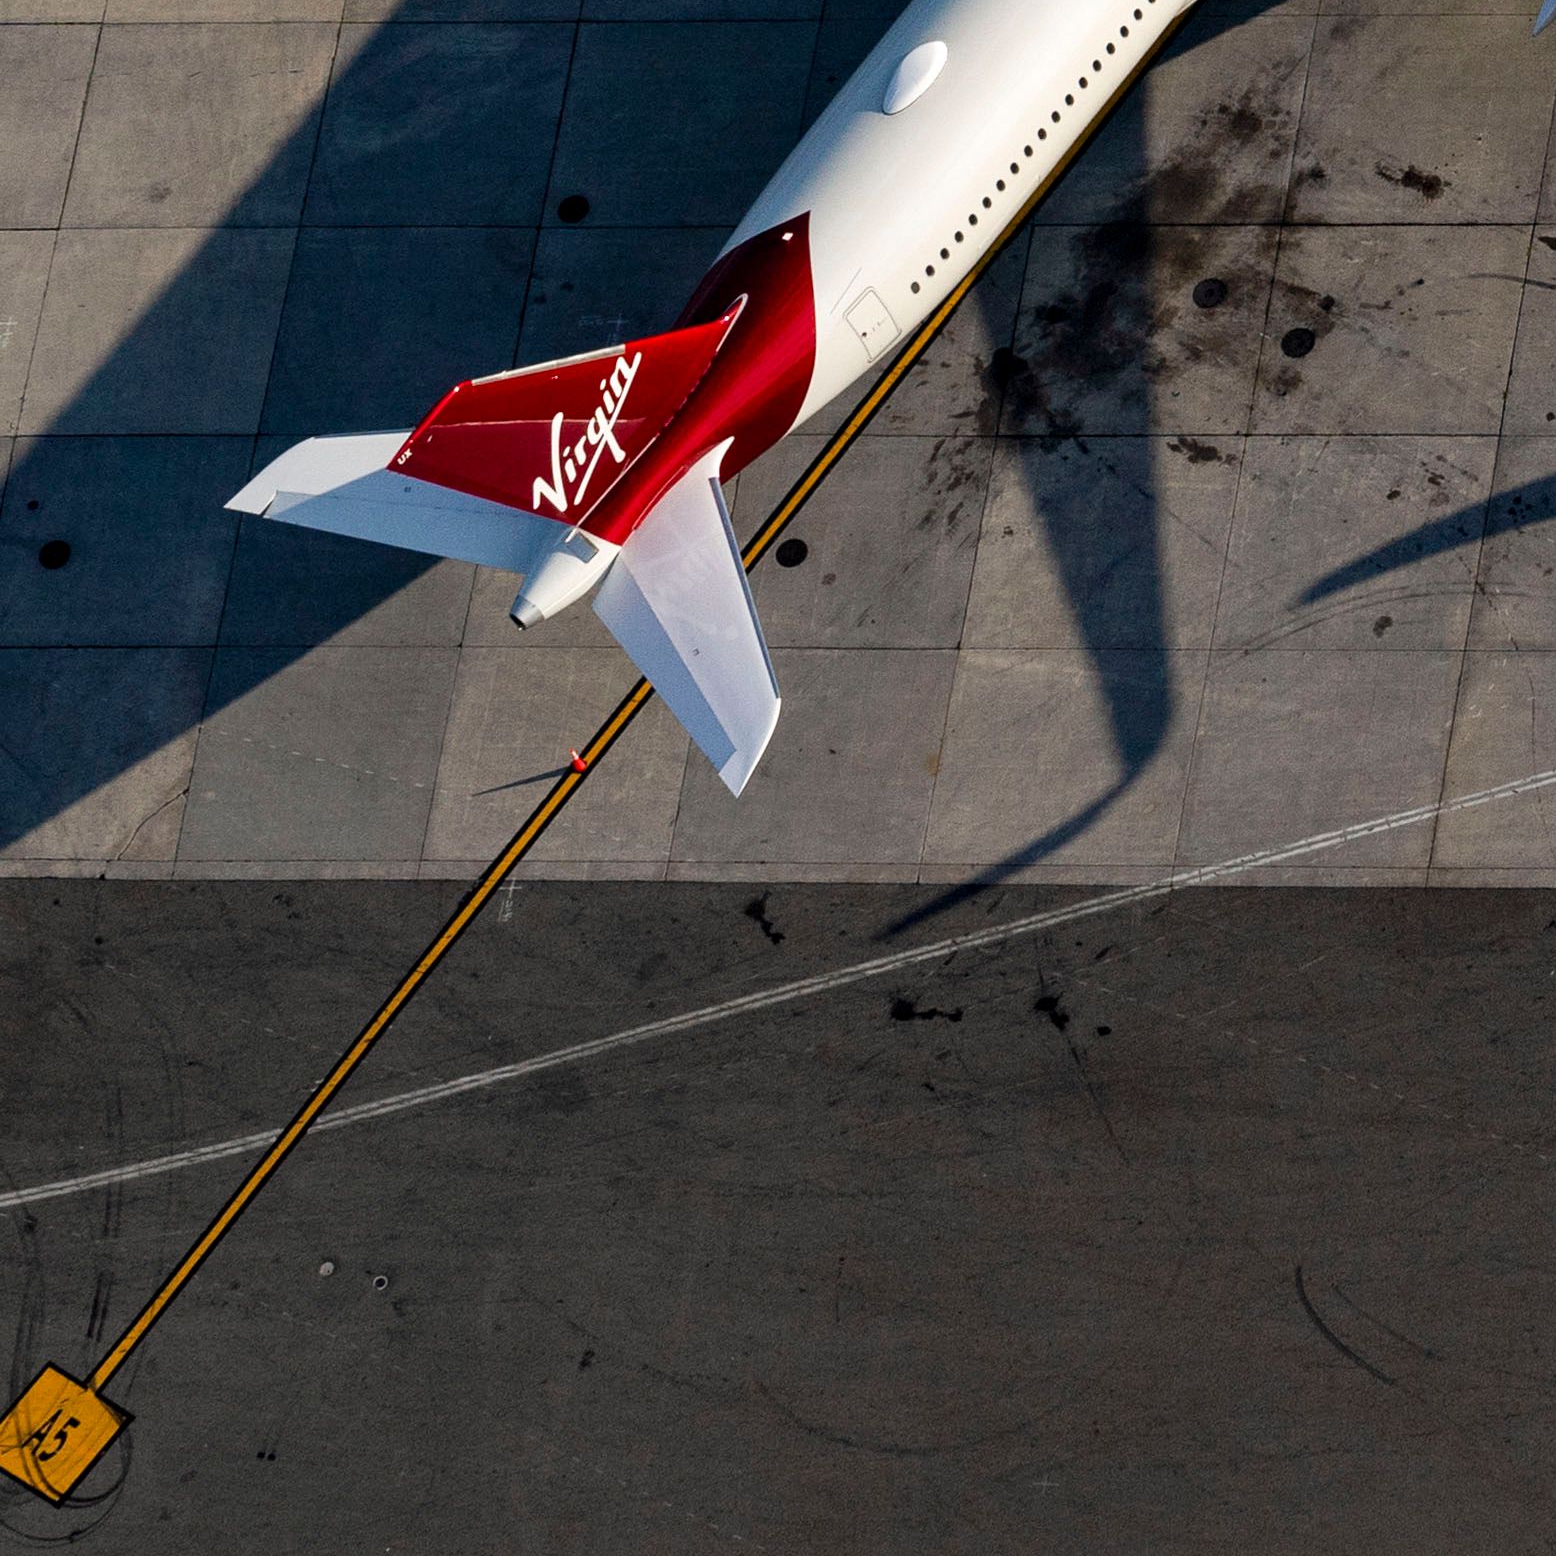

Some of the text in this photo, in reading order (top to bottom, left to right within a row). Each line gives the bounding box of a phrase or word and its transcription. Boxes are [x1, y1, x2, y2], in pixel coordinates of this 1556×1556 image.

[396, 447, 413, 466] UX
[532, 351, 642, 513] Virgin
[21, 1408, 80, 1461] A5
